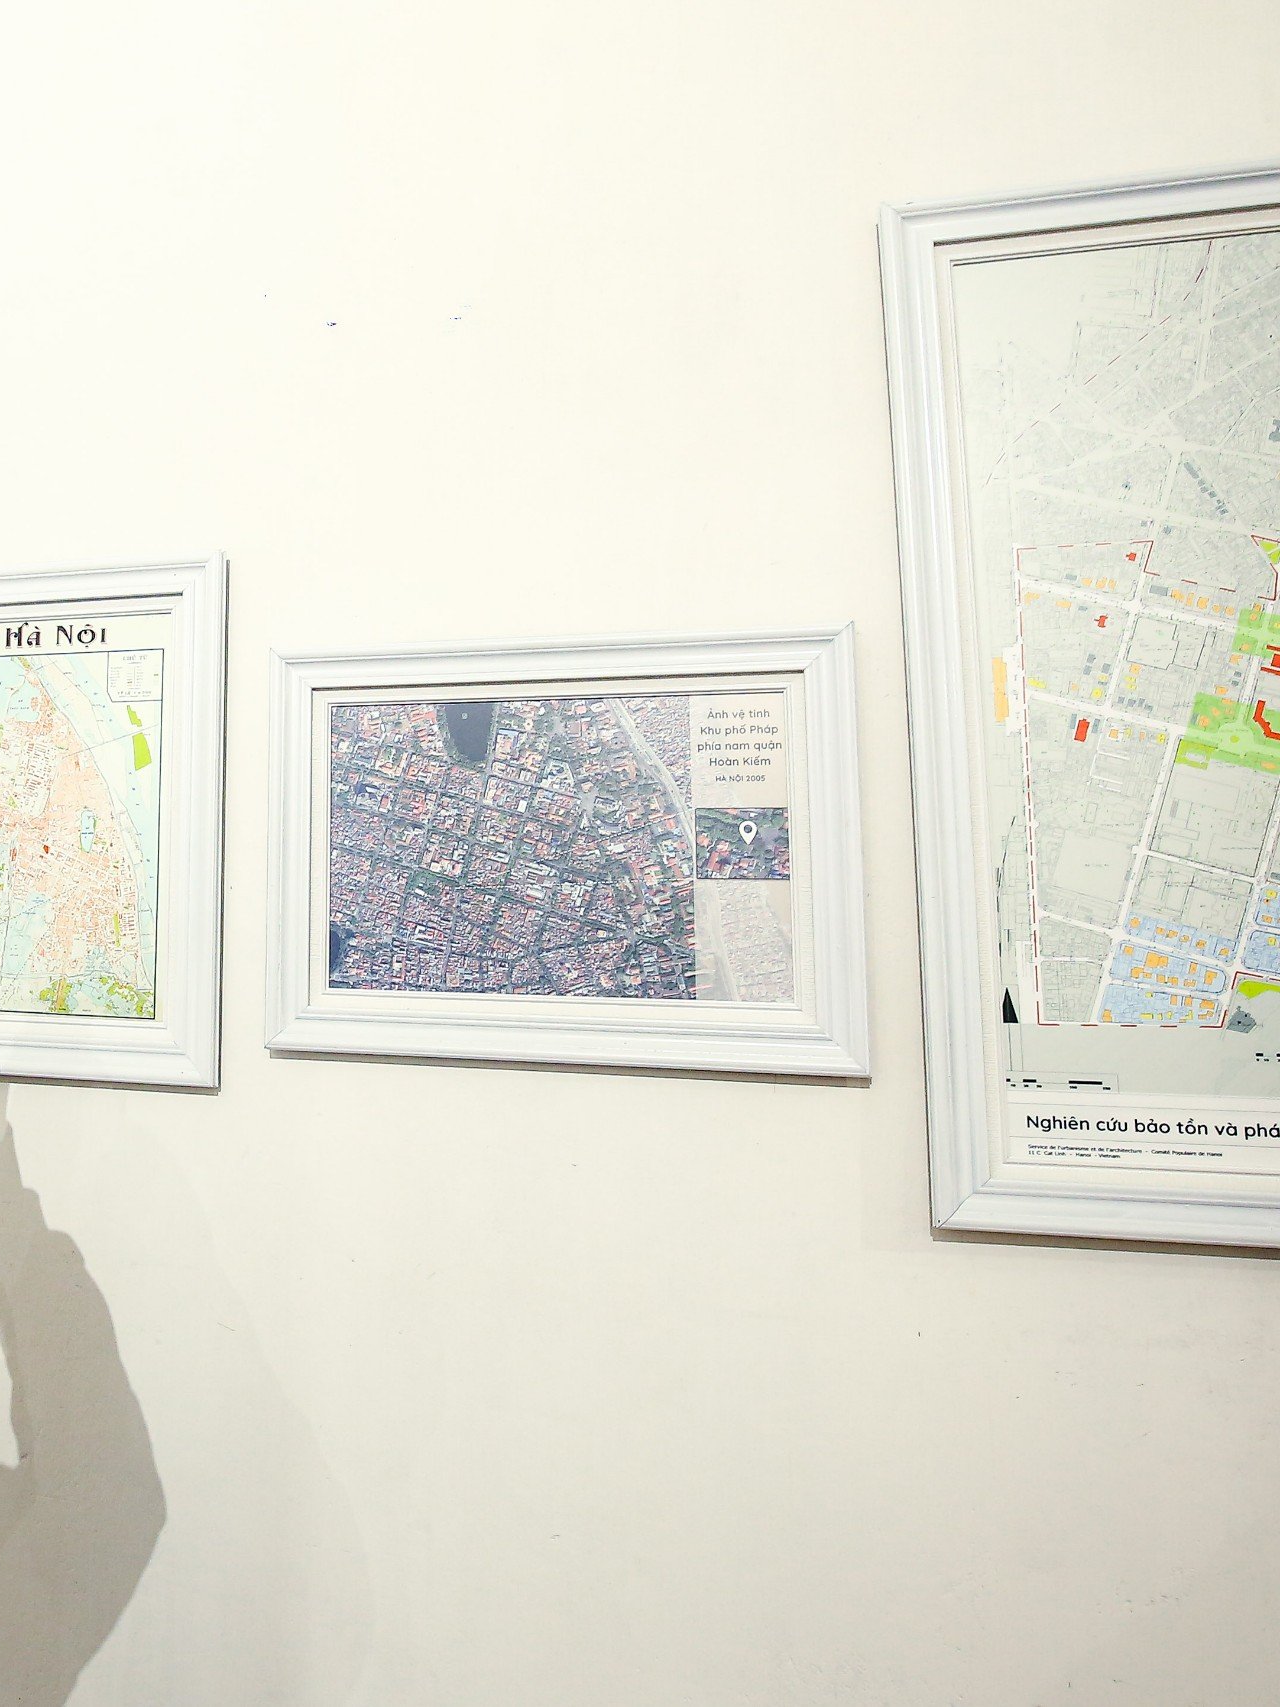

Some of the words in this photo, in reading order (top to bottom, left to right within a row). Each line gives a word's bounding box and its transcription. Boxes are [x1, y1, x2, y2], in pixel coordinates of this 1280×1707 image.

[5, 622, 42, 648] Hà
[707, 708, 729, 719] Ảnh
[732, 709, 745, 720] vệ
[700, 726, 721, 735] Khu
[725, 724, 746, 736] phố
[750, 724, 778, 736] Pháp
[697, 741, 721, 752] phía
[753, 740, 782, 751] quận
[709, 757, 739, 766] Hoàn
[743, 755, 771, 766] Kiếm
[746, 774, 766, 782] 2005
[1026, 1115, 1090, 1132] Nghiên
[1096, 1117, 1128, 1132] cứu
[1134, 1119, 1170, 1134] bảo
[1176, 1118, 1208, 1135] tồn
[1215, 1122, 1238, 1136] và
